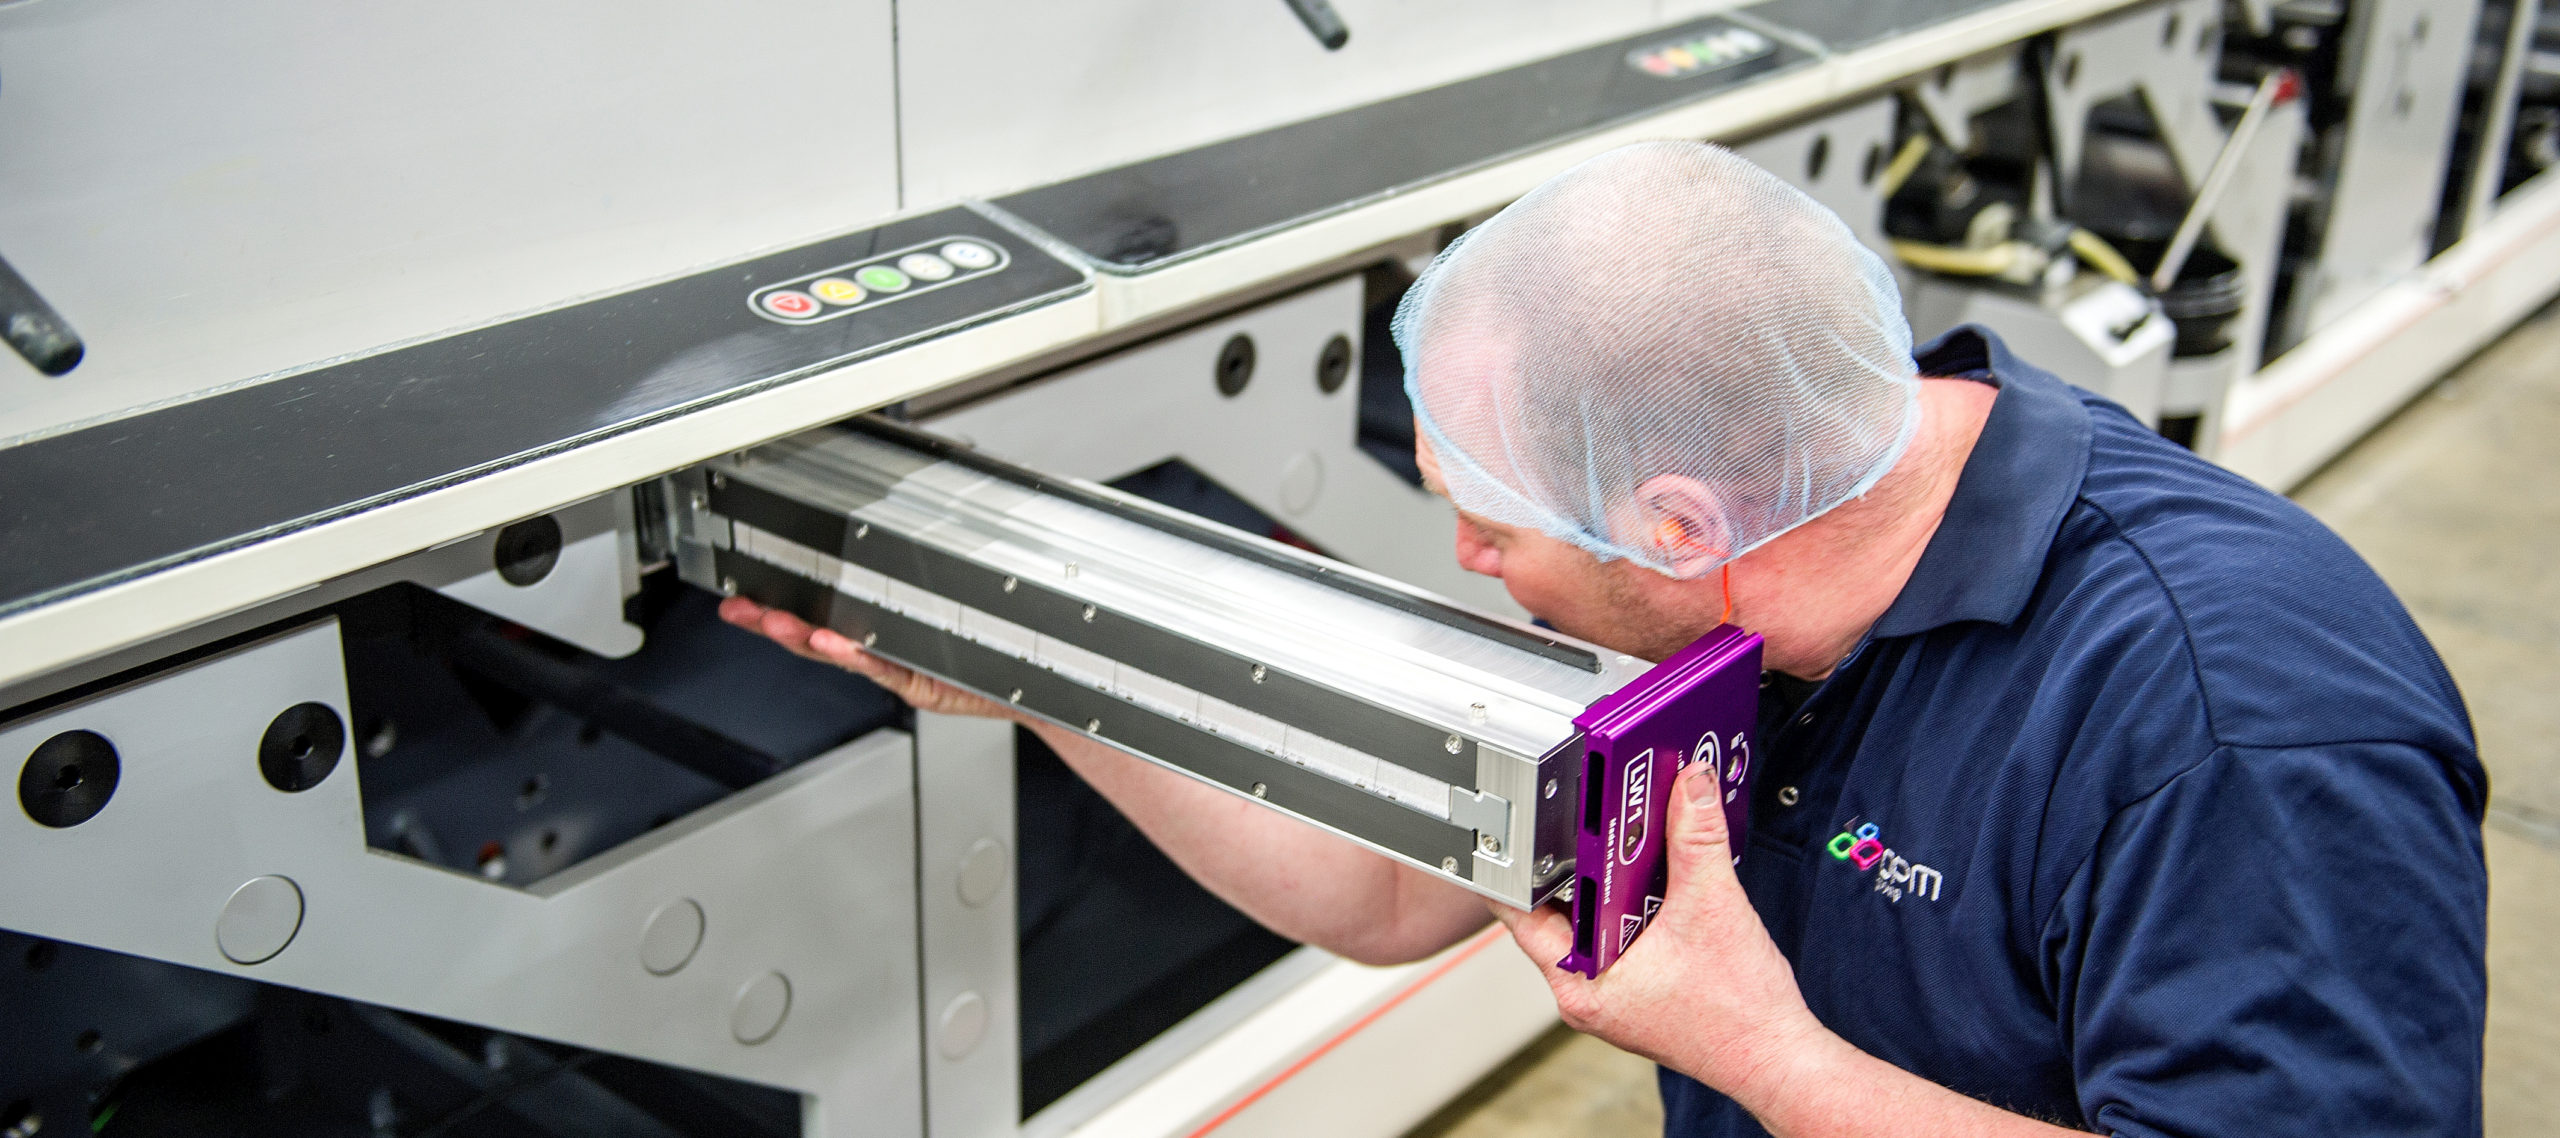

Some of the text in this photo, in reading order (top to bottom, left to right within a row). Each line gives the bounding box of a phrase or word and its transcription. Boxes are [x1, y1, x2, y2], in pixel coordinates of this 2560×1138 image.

[1627, 762, 1647, 824] LW1
[1607, 817, 1617, 847] Made
[1603, 860, 1614, 905] England
